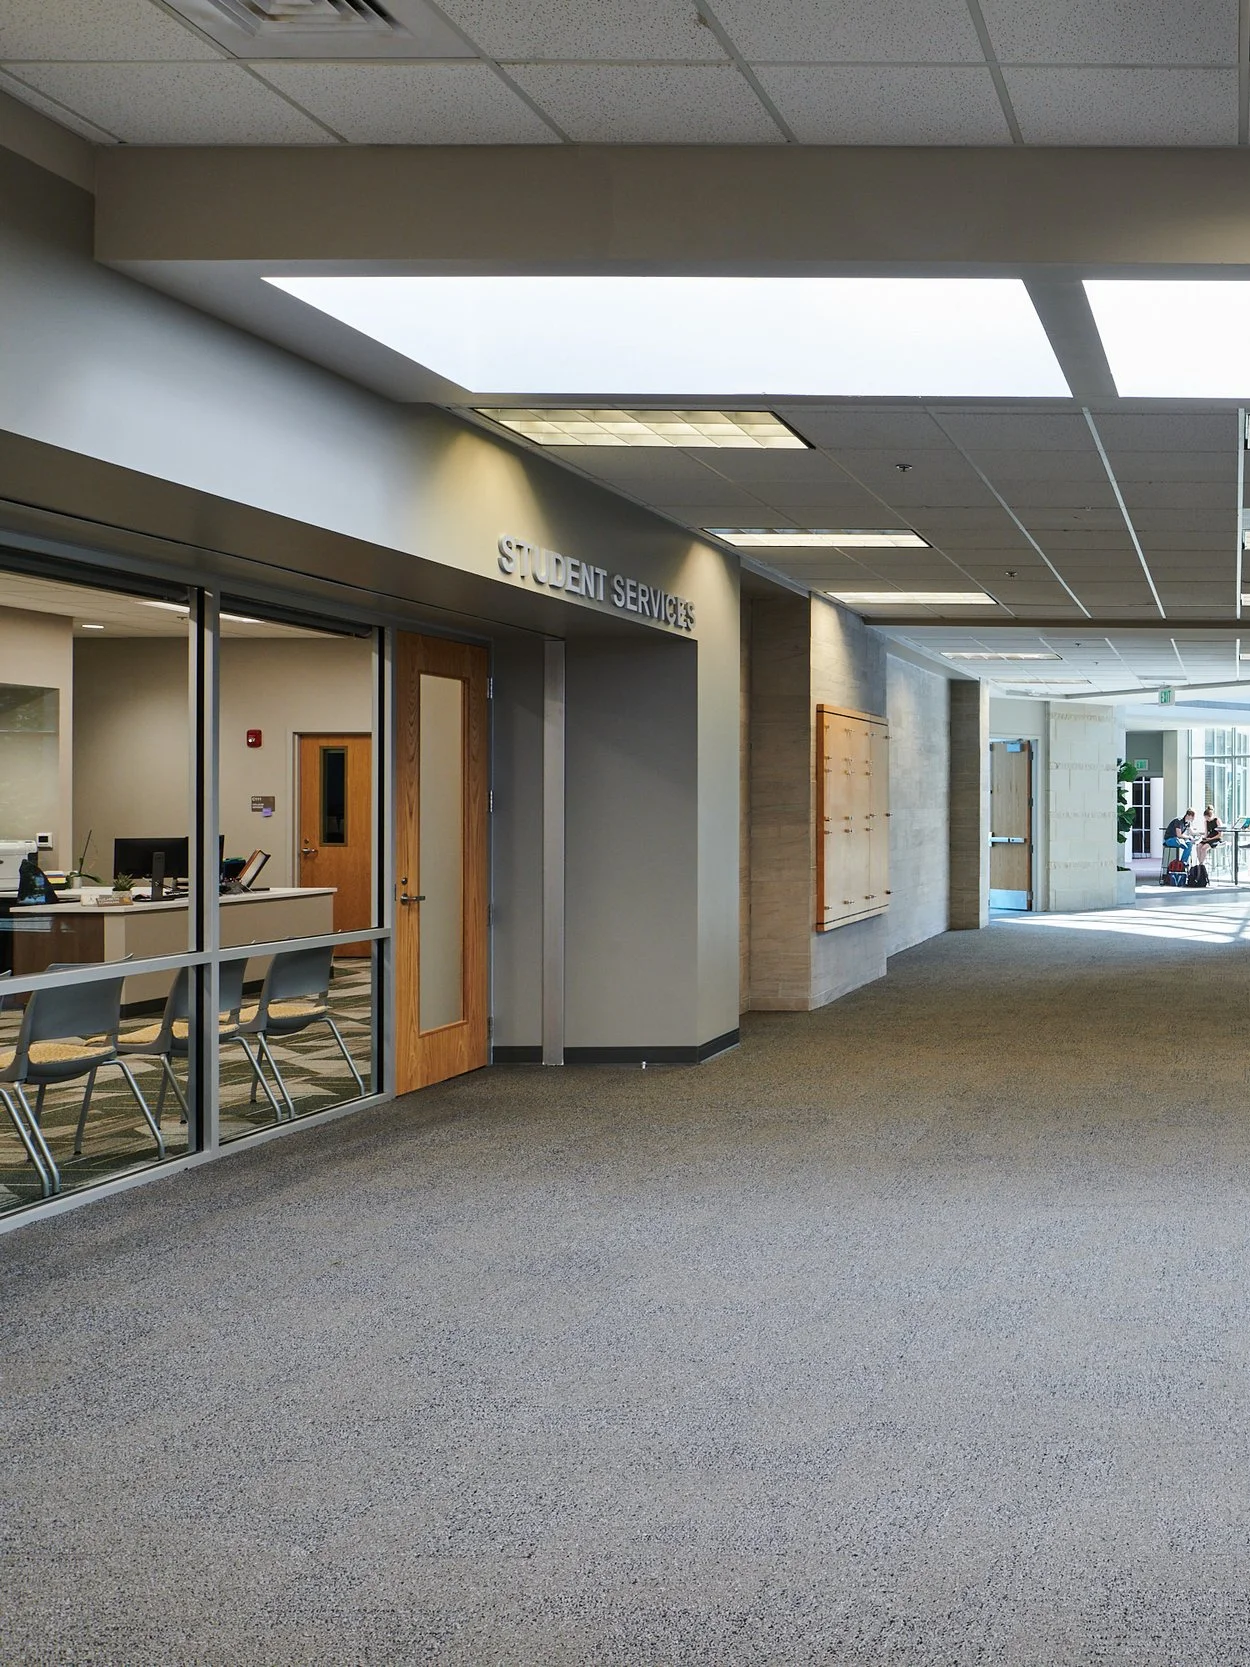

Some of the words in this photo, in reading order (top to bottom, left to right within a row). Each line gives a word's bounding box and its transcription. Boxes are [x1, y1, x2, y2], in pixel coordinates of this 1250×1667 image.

[497, 533, 608, 601] STUDENT
[613, 574, 696, 631] SERVICES
[1160, 690, 1171, 703] EXIT
